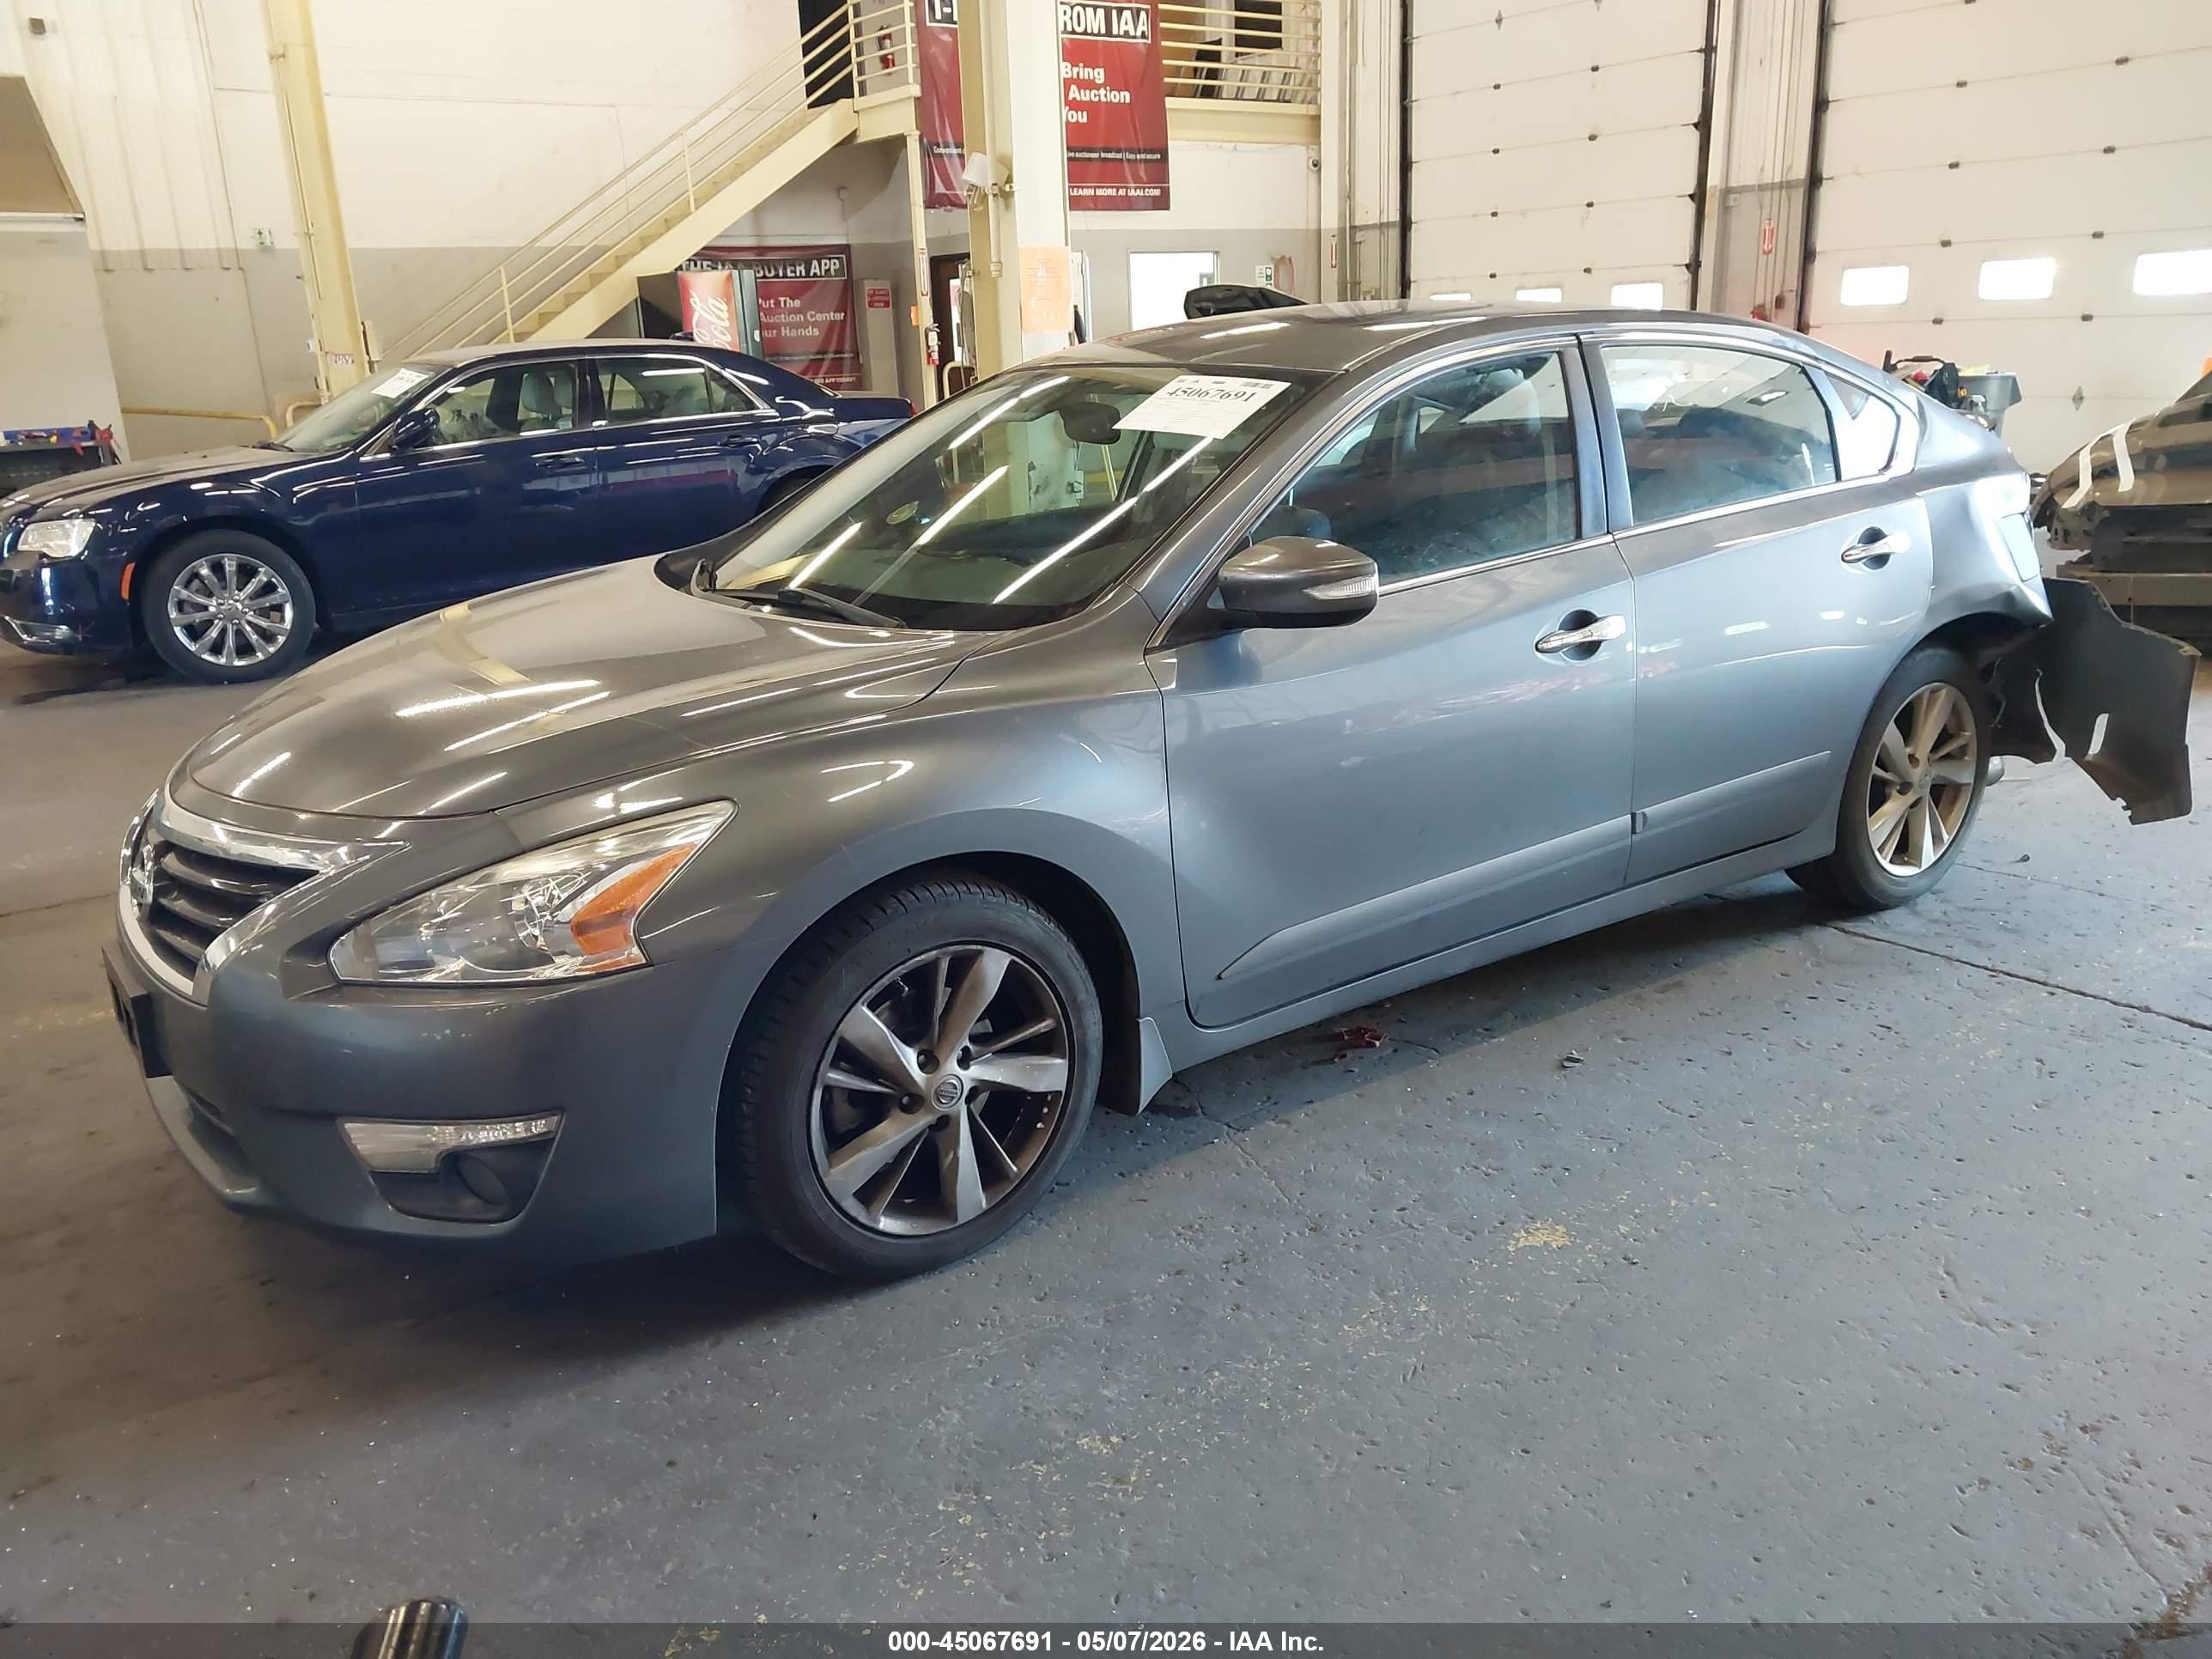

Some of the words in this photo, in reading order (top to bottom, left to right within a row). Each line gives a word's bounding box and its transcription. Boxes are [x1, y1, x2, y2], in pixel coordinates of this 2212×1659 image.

[1111, 9, 1149, 37] IAA
[1062, 61, 1105, 84] Bring
[1068, 84, 1131, 104] Auction
[1070, 187, 1095, 196] LEARN
[1096, 187, 1117, 197] MORE
[1118, 188, 1127, 197] AT
[755, 259, 806, 278] BUYER
[809, 258, 841, 277] APP
[778, 296, 801, 308] The
[759, 312, 805, 324] Auction
[806, 310, 846, 323] Center
[781, 325, 820, 337] Hands
[1166, 386, 1257, 403] 45067691
